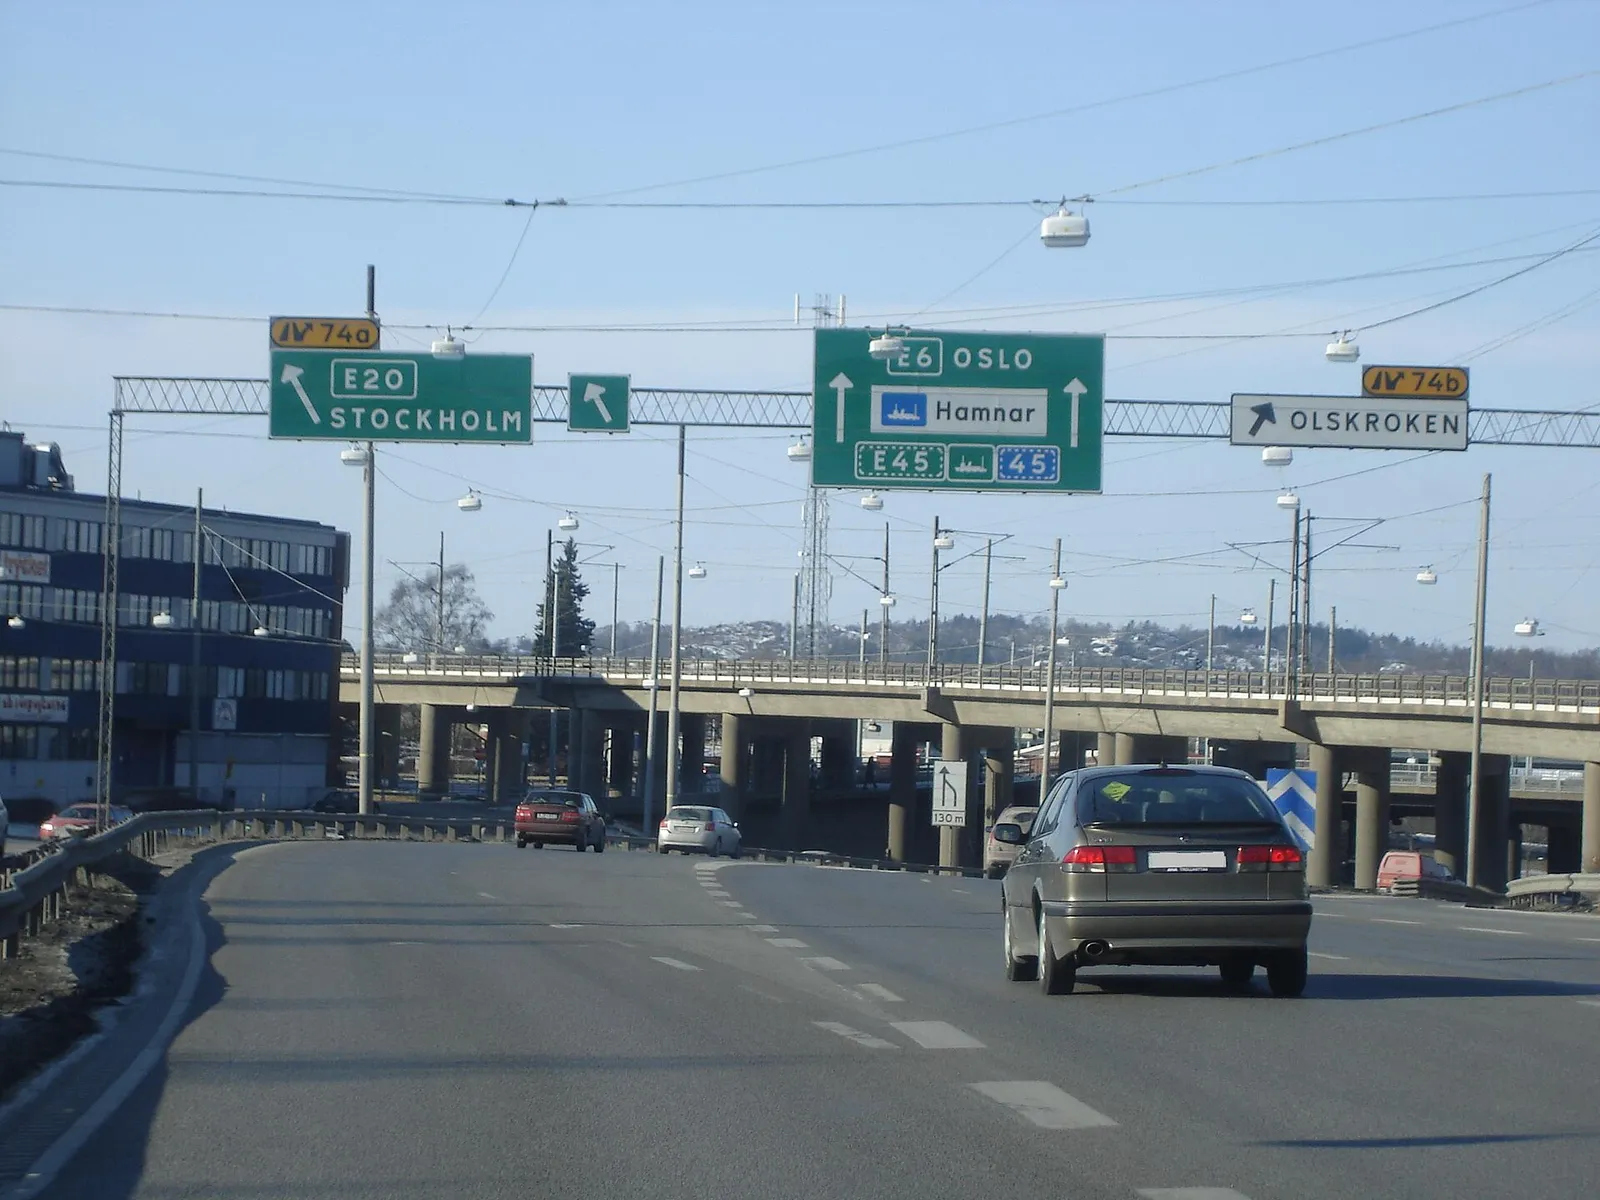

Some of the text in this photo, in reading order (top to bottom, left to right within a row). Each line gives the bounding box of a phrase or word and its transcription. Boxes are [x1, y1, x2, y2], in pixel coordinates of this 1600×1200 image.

[320, 323, 370, 343] 74a
[898, 346, 1033, 369] E6 OSLO
[344, 367, 404, 390] E20
[1411, 372, 1460, 392] 74b
[330, 407, 522, 432] STOCKHOLM
[935, 401, 1036, 422] Hamnar
[1290, 411, 1459, 434] OLSKROKEN
[873, 450, 1046, 474] E45 45
[934, 814, 952, 823] 130
